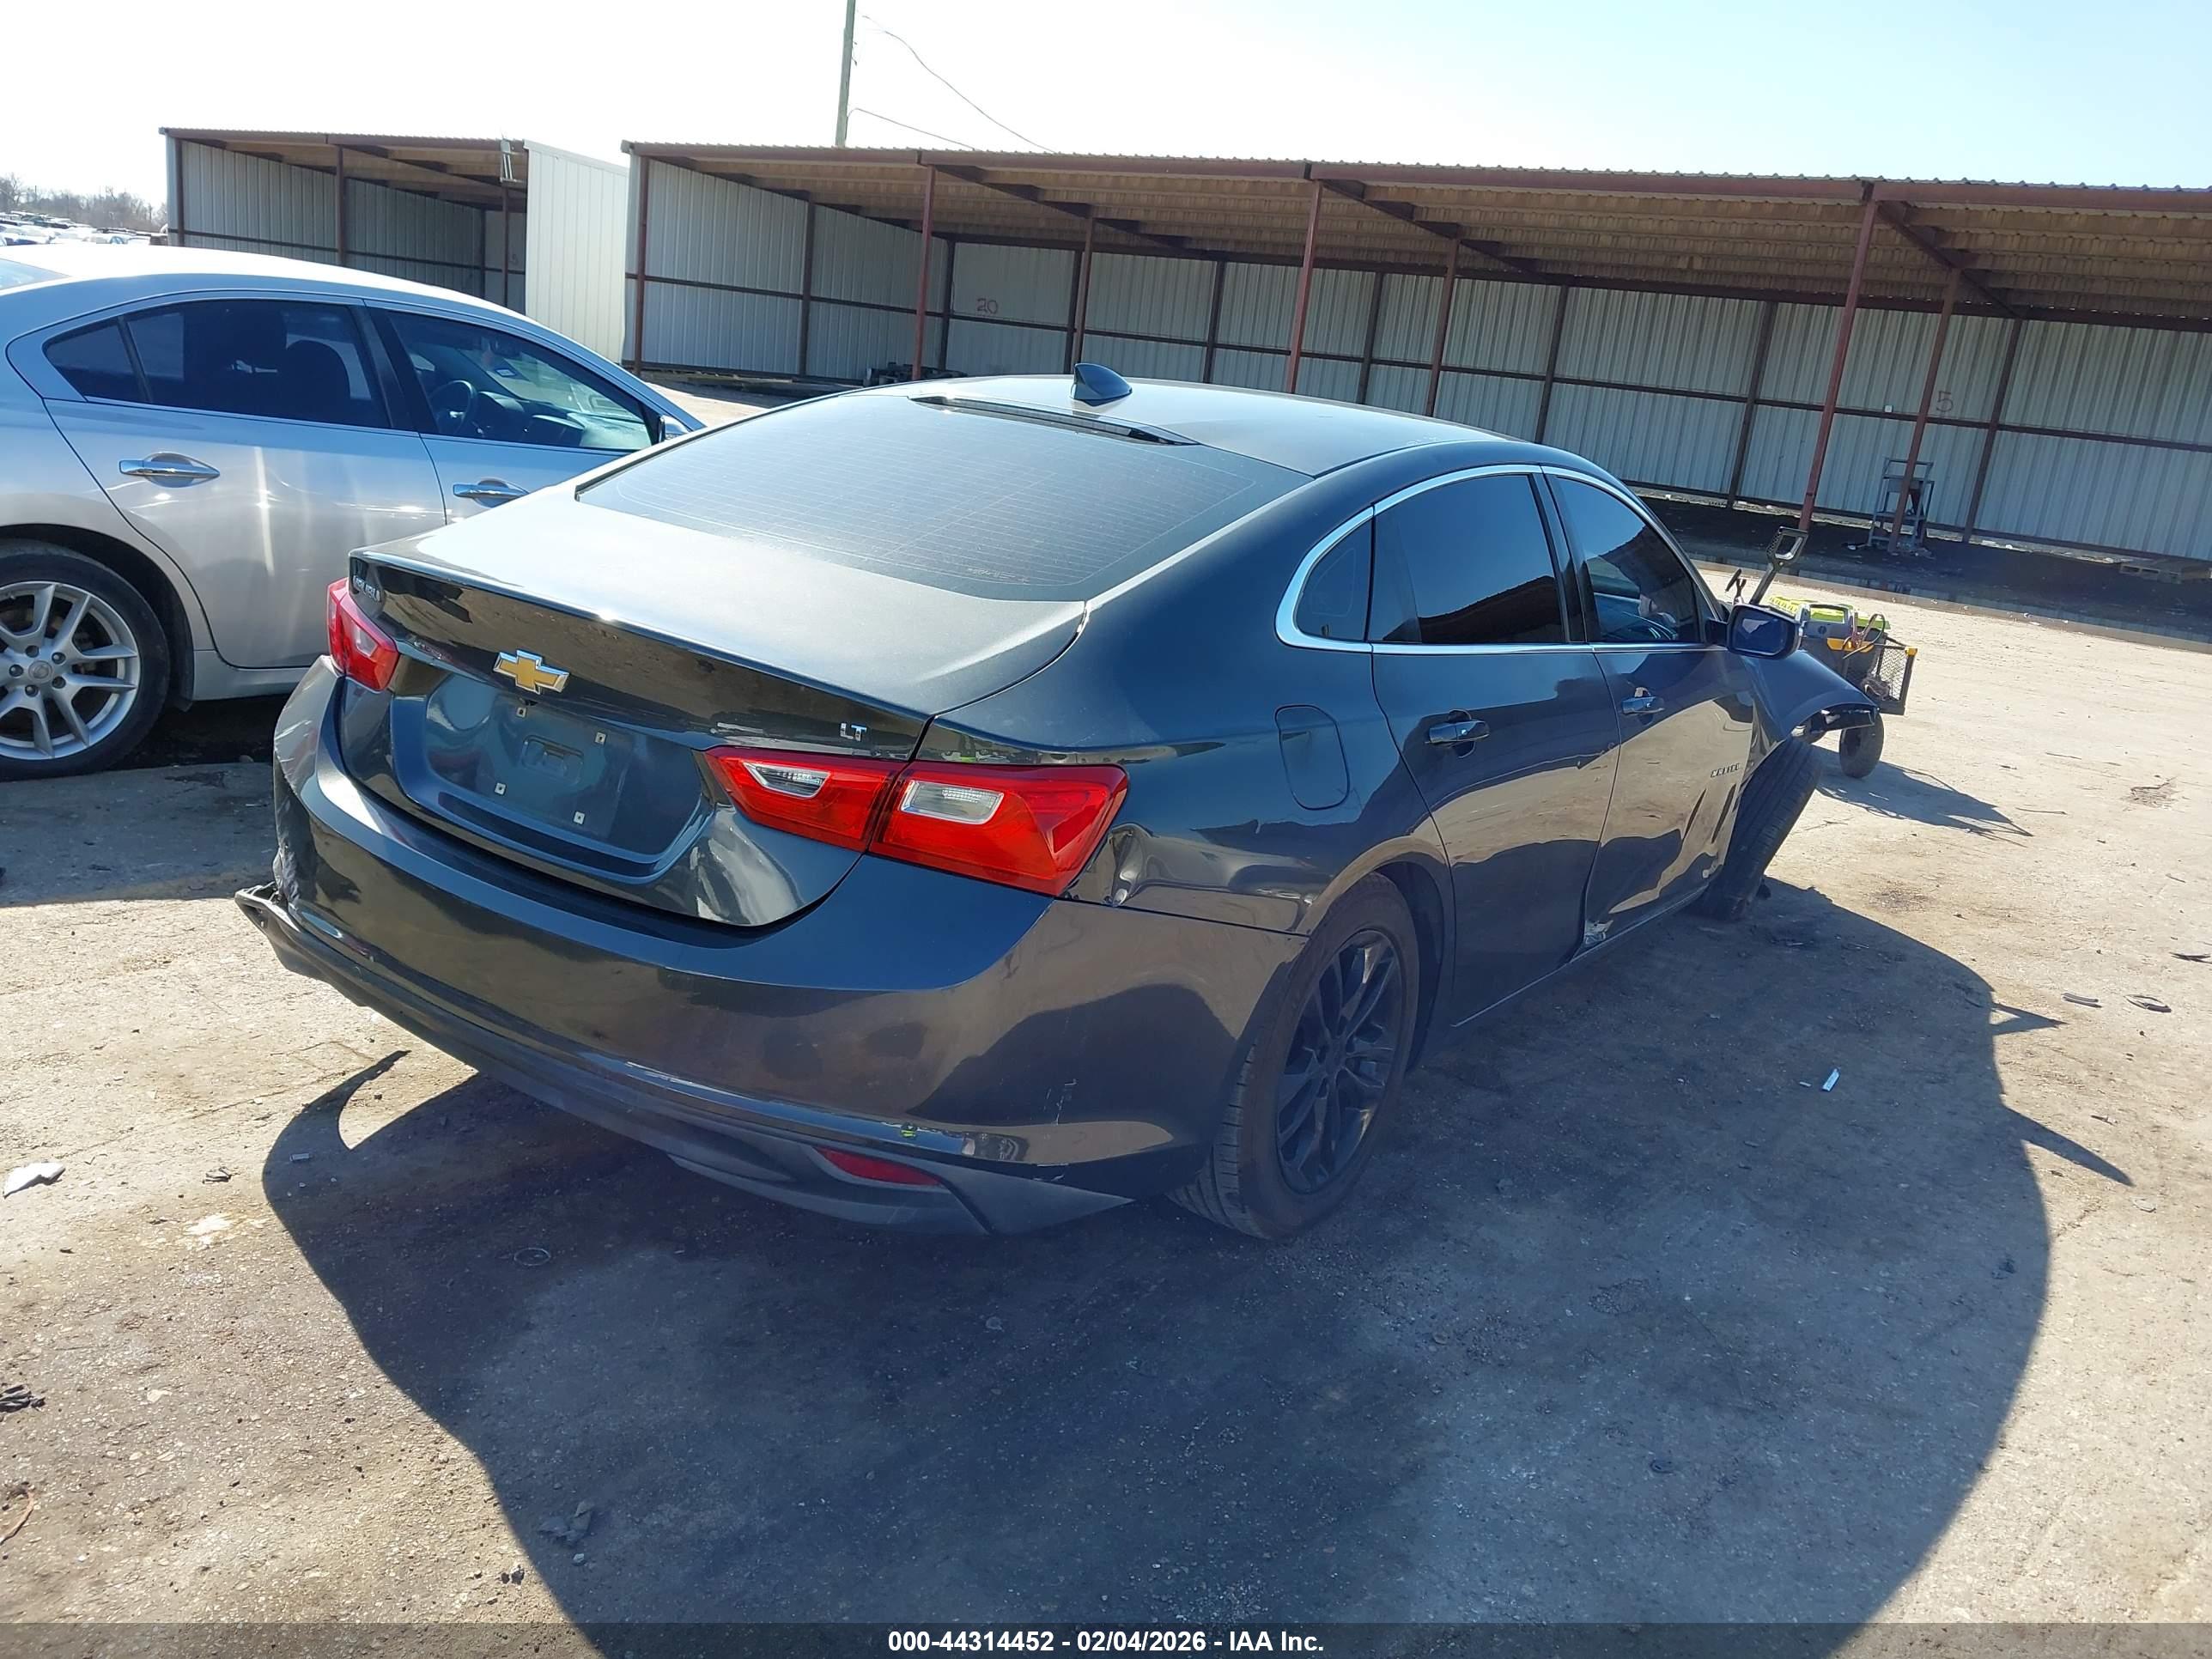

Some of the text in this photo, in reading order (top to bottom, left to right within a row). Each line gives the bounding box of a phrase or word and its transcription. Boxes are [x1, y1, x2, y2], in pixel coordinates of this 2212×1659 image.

[976, 297, 1000, 314] 20
[1936, 390, 1954, 412] 5
[840, 722, 867, 742] LT
